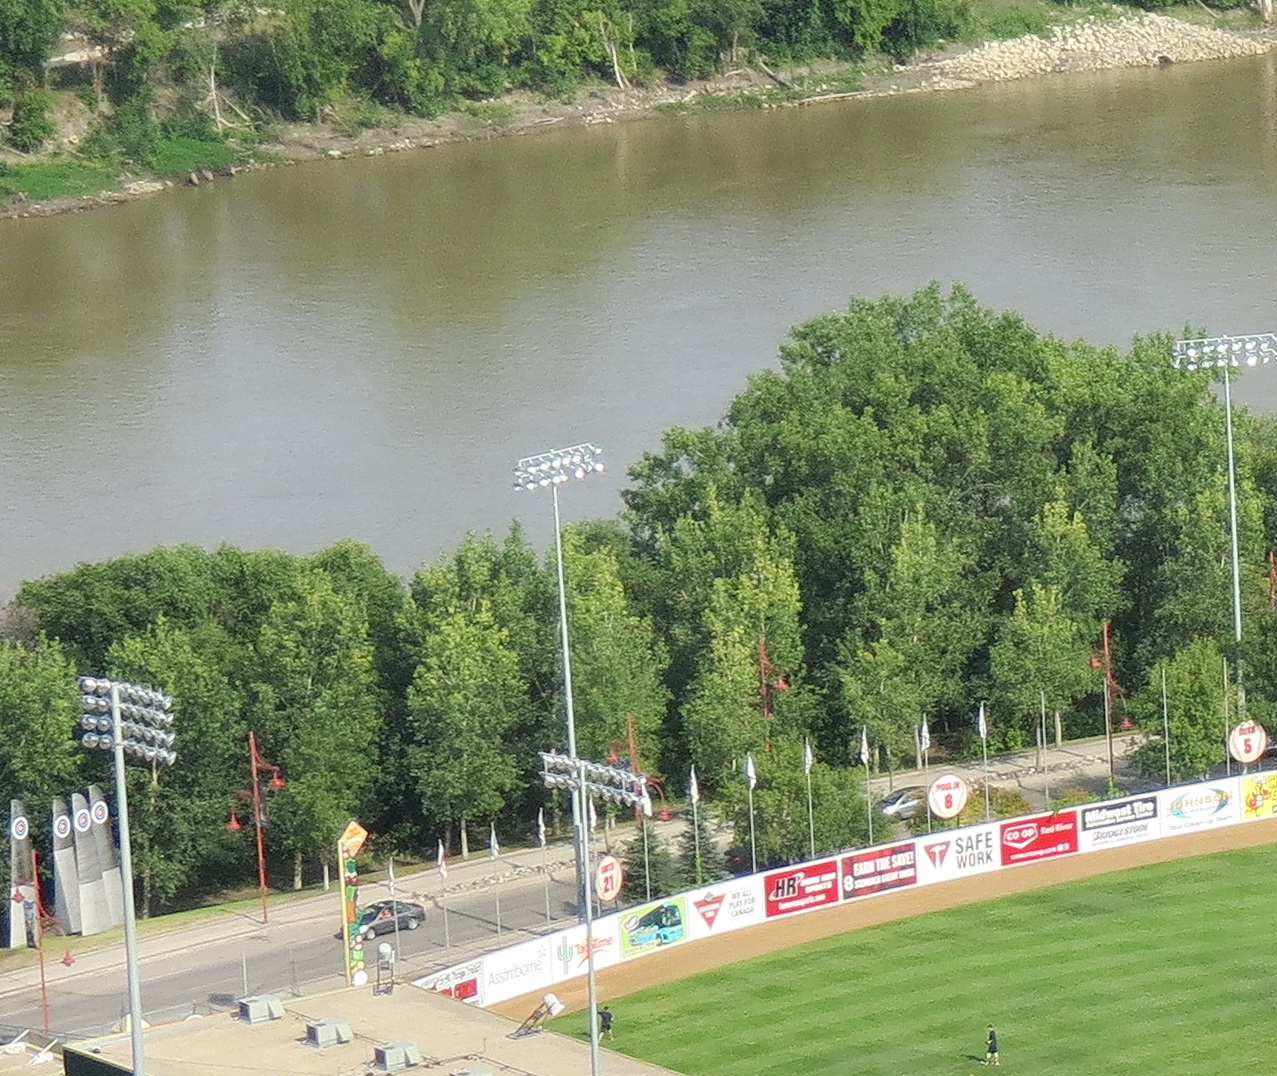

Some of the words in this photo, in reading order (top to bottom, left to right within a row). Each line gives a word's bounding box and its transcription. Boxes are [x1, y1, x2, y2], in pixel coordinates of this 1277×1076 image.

[1243, 739, 1252, 753] 5
[944, 794, 953, 809] 8
[1166, 791, 1234, 812] JOHNSON
[1085, 806, 1133, 824] Midwest
[1133, 801, 1155, 814] Tire
[1040, 825, 1055, 835] Red
[1055, 822, 1073, 832] River
[955, 831, 993, 854] SAFE
[956, 850, 994, 870] WORK
[603, 876, 614, 892] 21
[775, 876, 798, 898] HR
